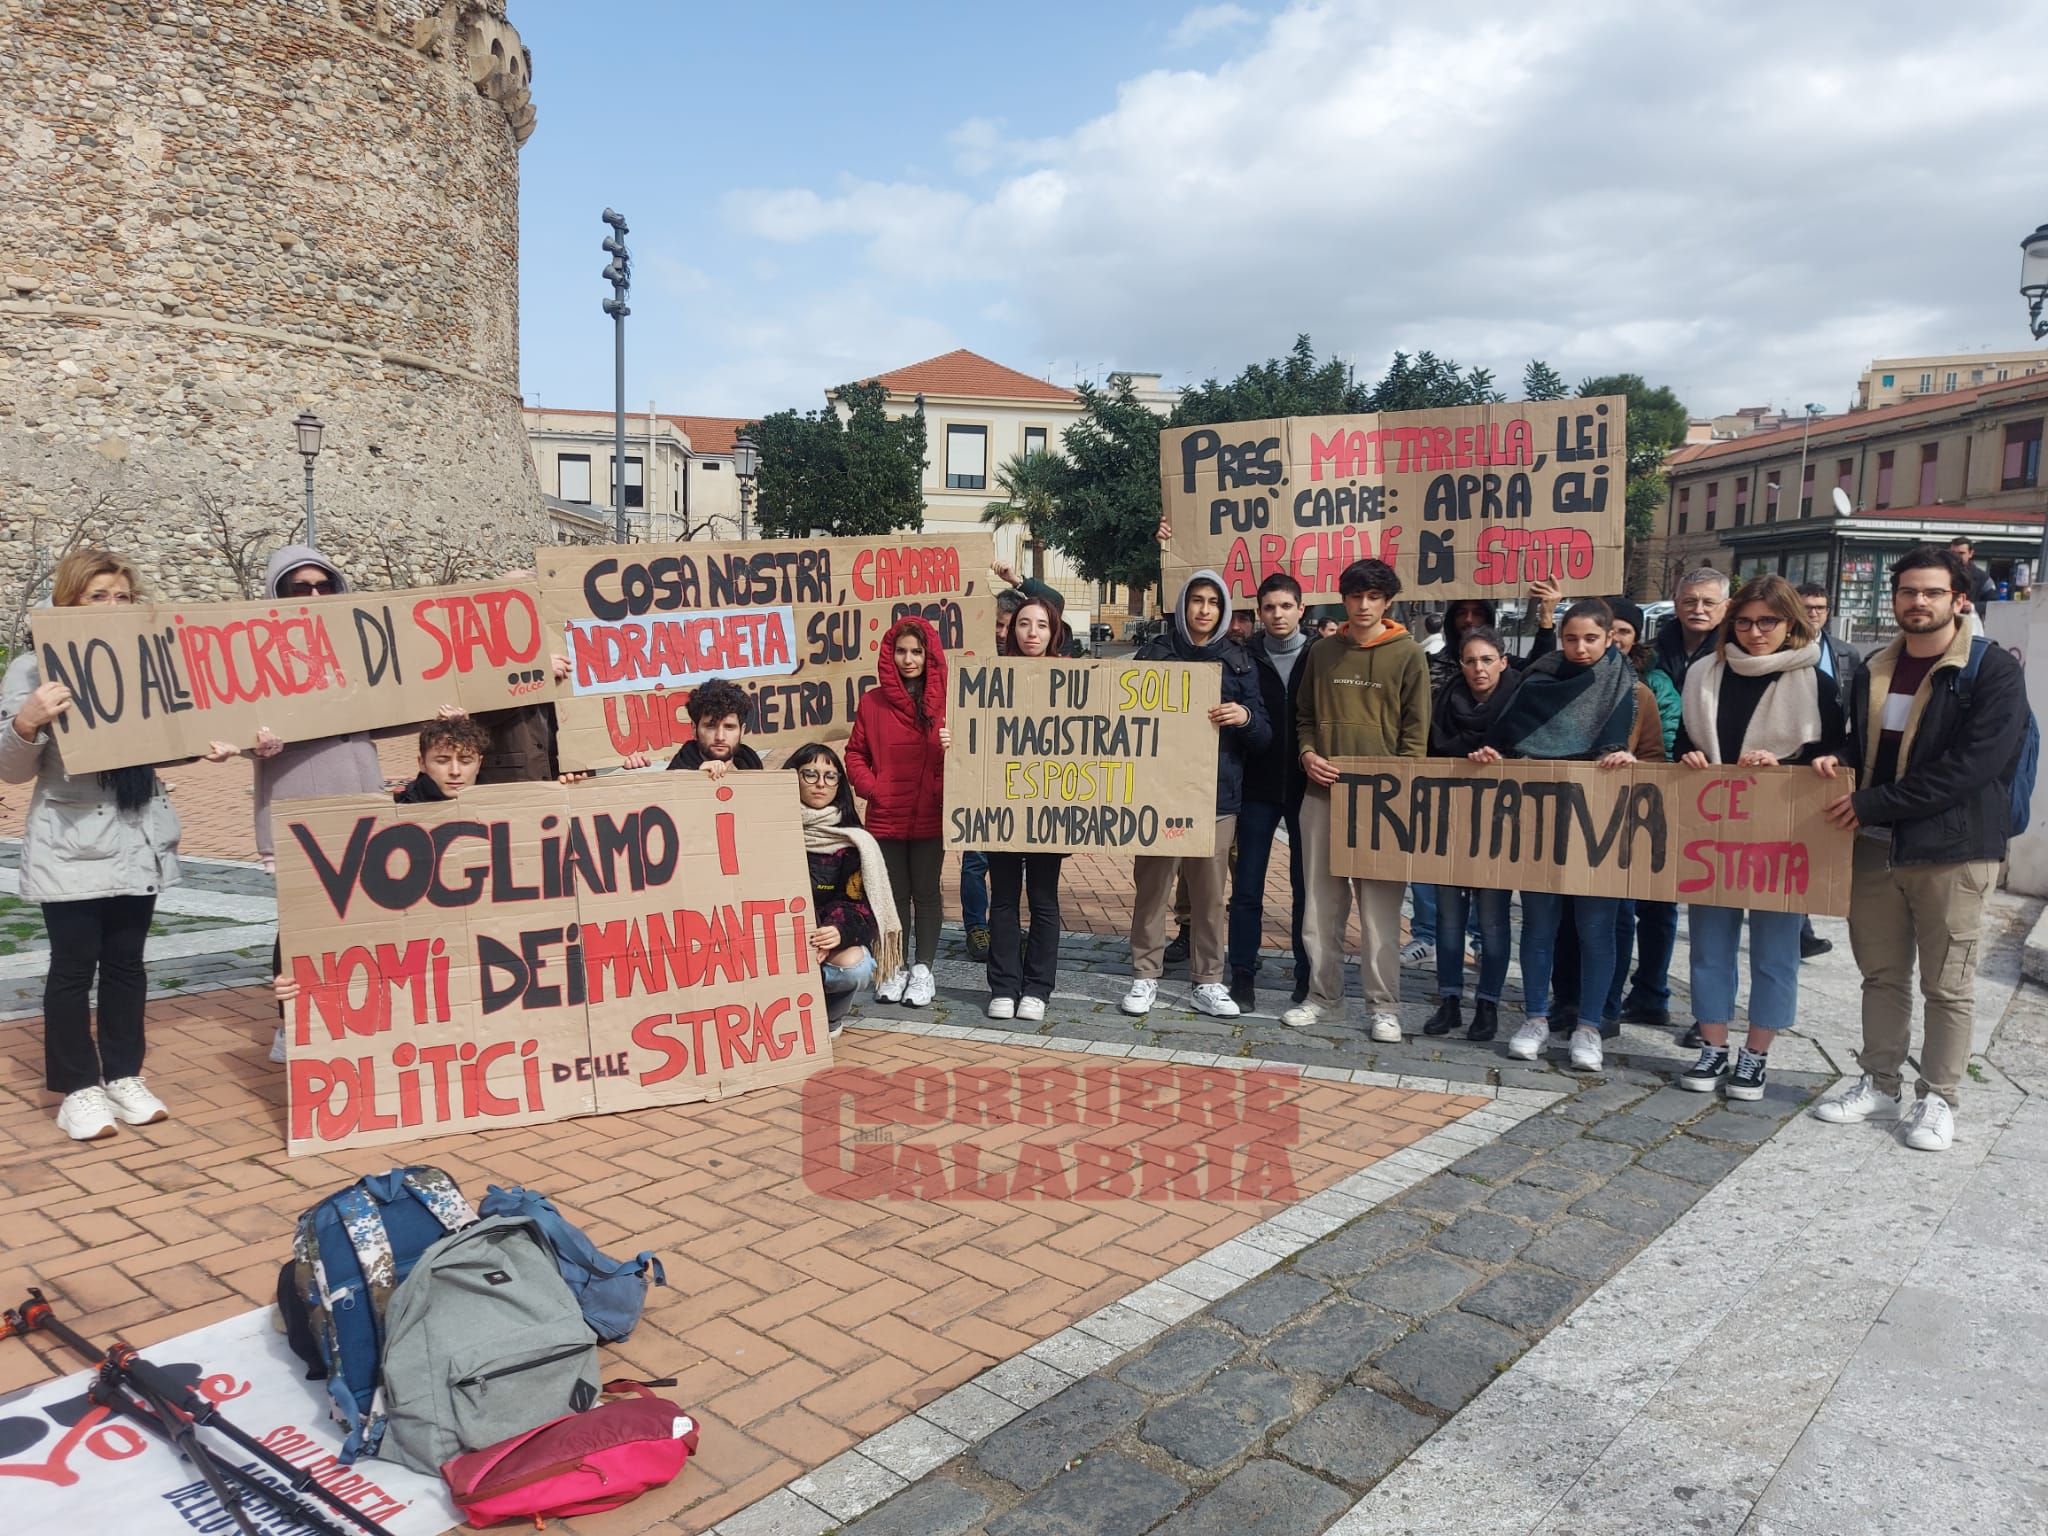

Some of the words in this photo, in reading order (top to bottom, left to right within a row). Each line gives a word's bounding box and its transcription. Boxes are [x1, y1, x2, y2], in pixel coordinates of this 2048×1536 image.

[1423, 472, 1533, 522] APRA
[1473, 526, 1594, 586] STATO
[583, 555, 701, 621] COSA
[707, 548, 846, 607] NOSTRA,
[42, 637, 124, 735] NO
[352, 604, 402, 688] DI
[411, 589, 541, 680] STATO
[508, 669, 545, 685] OUR
[959, 666, 1014, 709] MAI
[1119, 669, 1190, 713] SOLI
[969, 718, 976, 755] I
[996, 715, 1160, 757] MAGISTRATI
[1005, 761, 1134, 804] ESPOSTI
[951, 806, 1014, 844] SIAMO
[1026, 805, 1158, 847] LOMBARDO
[1165, 817, 1194, 829] OUR
[1336, 772, 1666, 873] TRATTATIVA
[1678, 839, 1809, 895] STATA
[552, 1051, 630, 1083] DELLE
